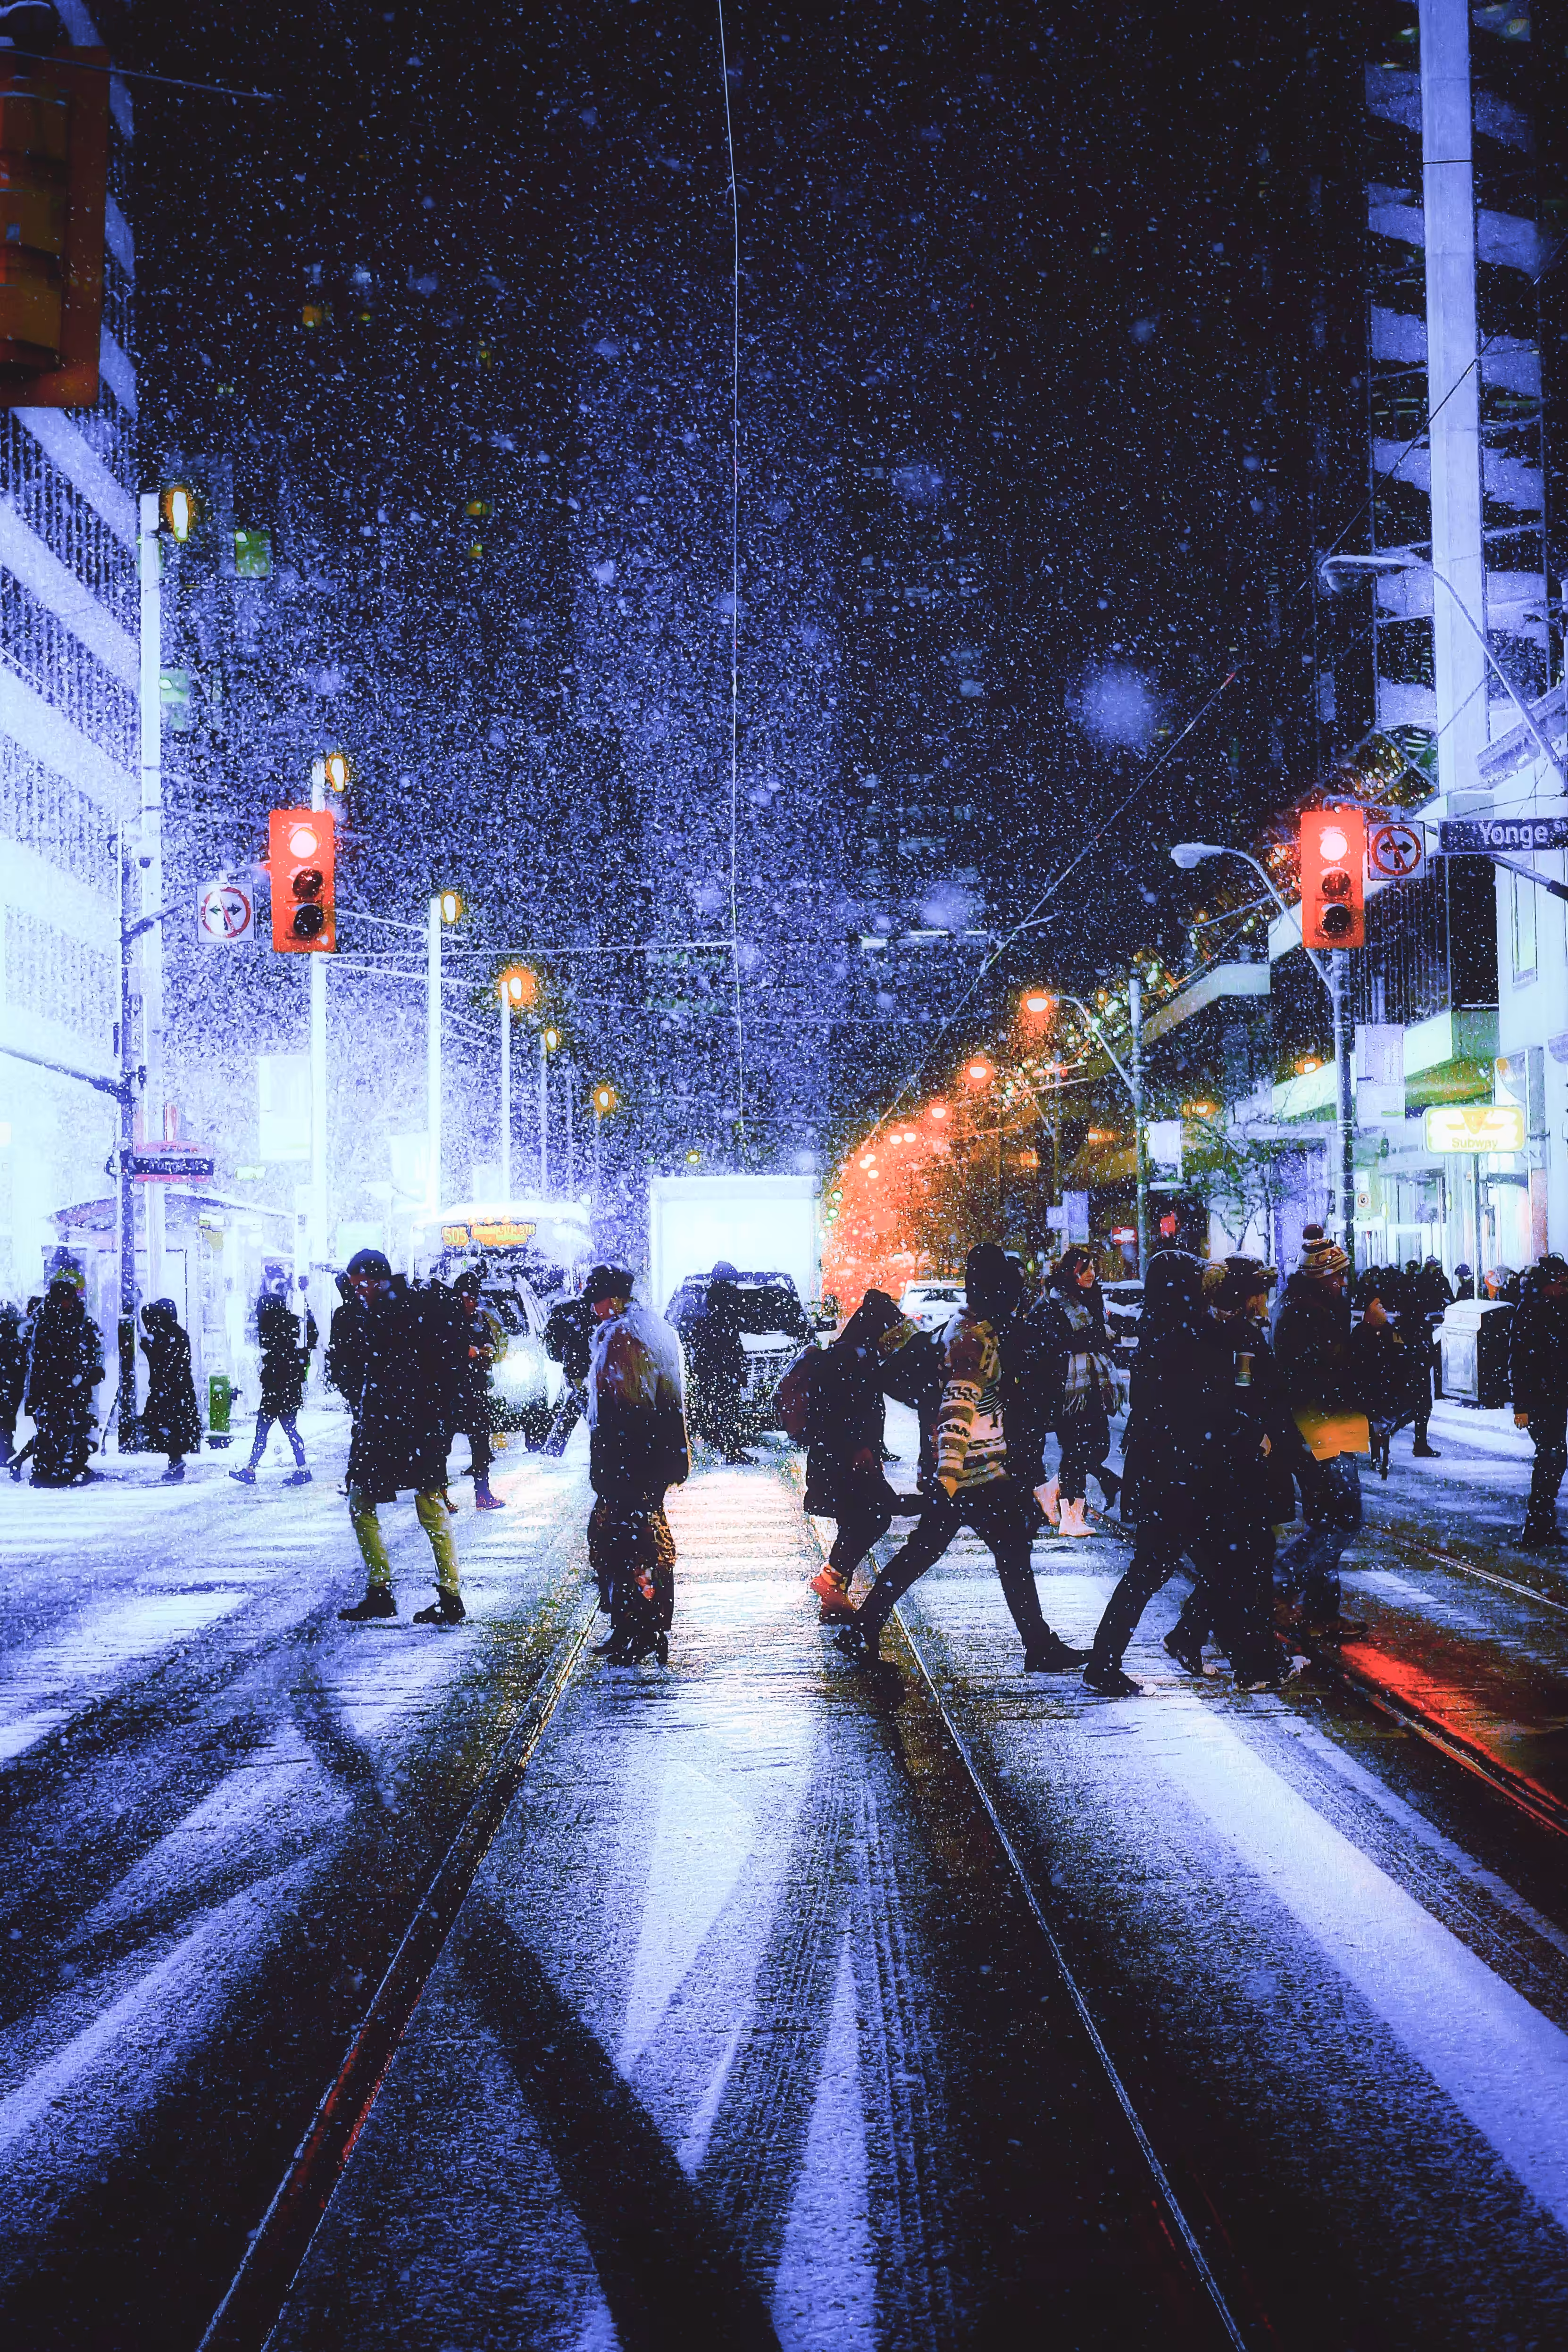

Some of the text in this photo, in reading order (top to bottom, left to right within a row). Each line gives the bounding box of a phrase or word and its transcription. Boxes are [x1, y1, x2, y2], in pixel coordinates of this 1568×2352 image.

[1478, 820, 1548, 849] Yonge
[1451, 1137, 1498, 1151] Subway
[444, 1227, 467, 1243] 505
